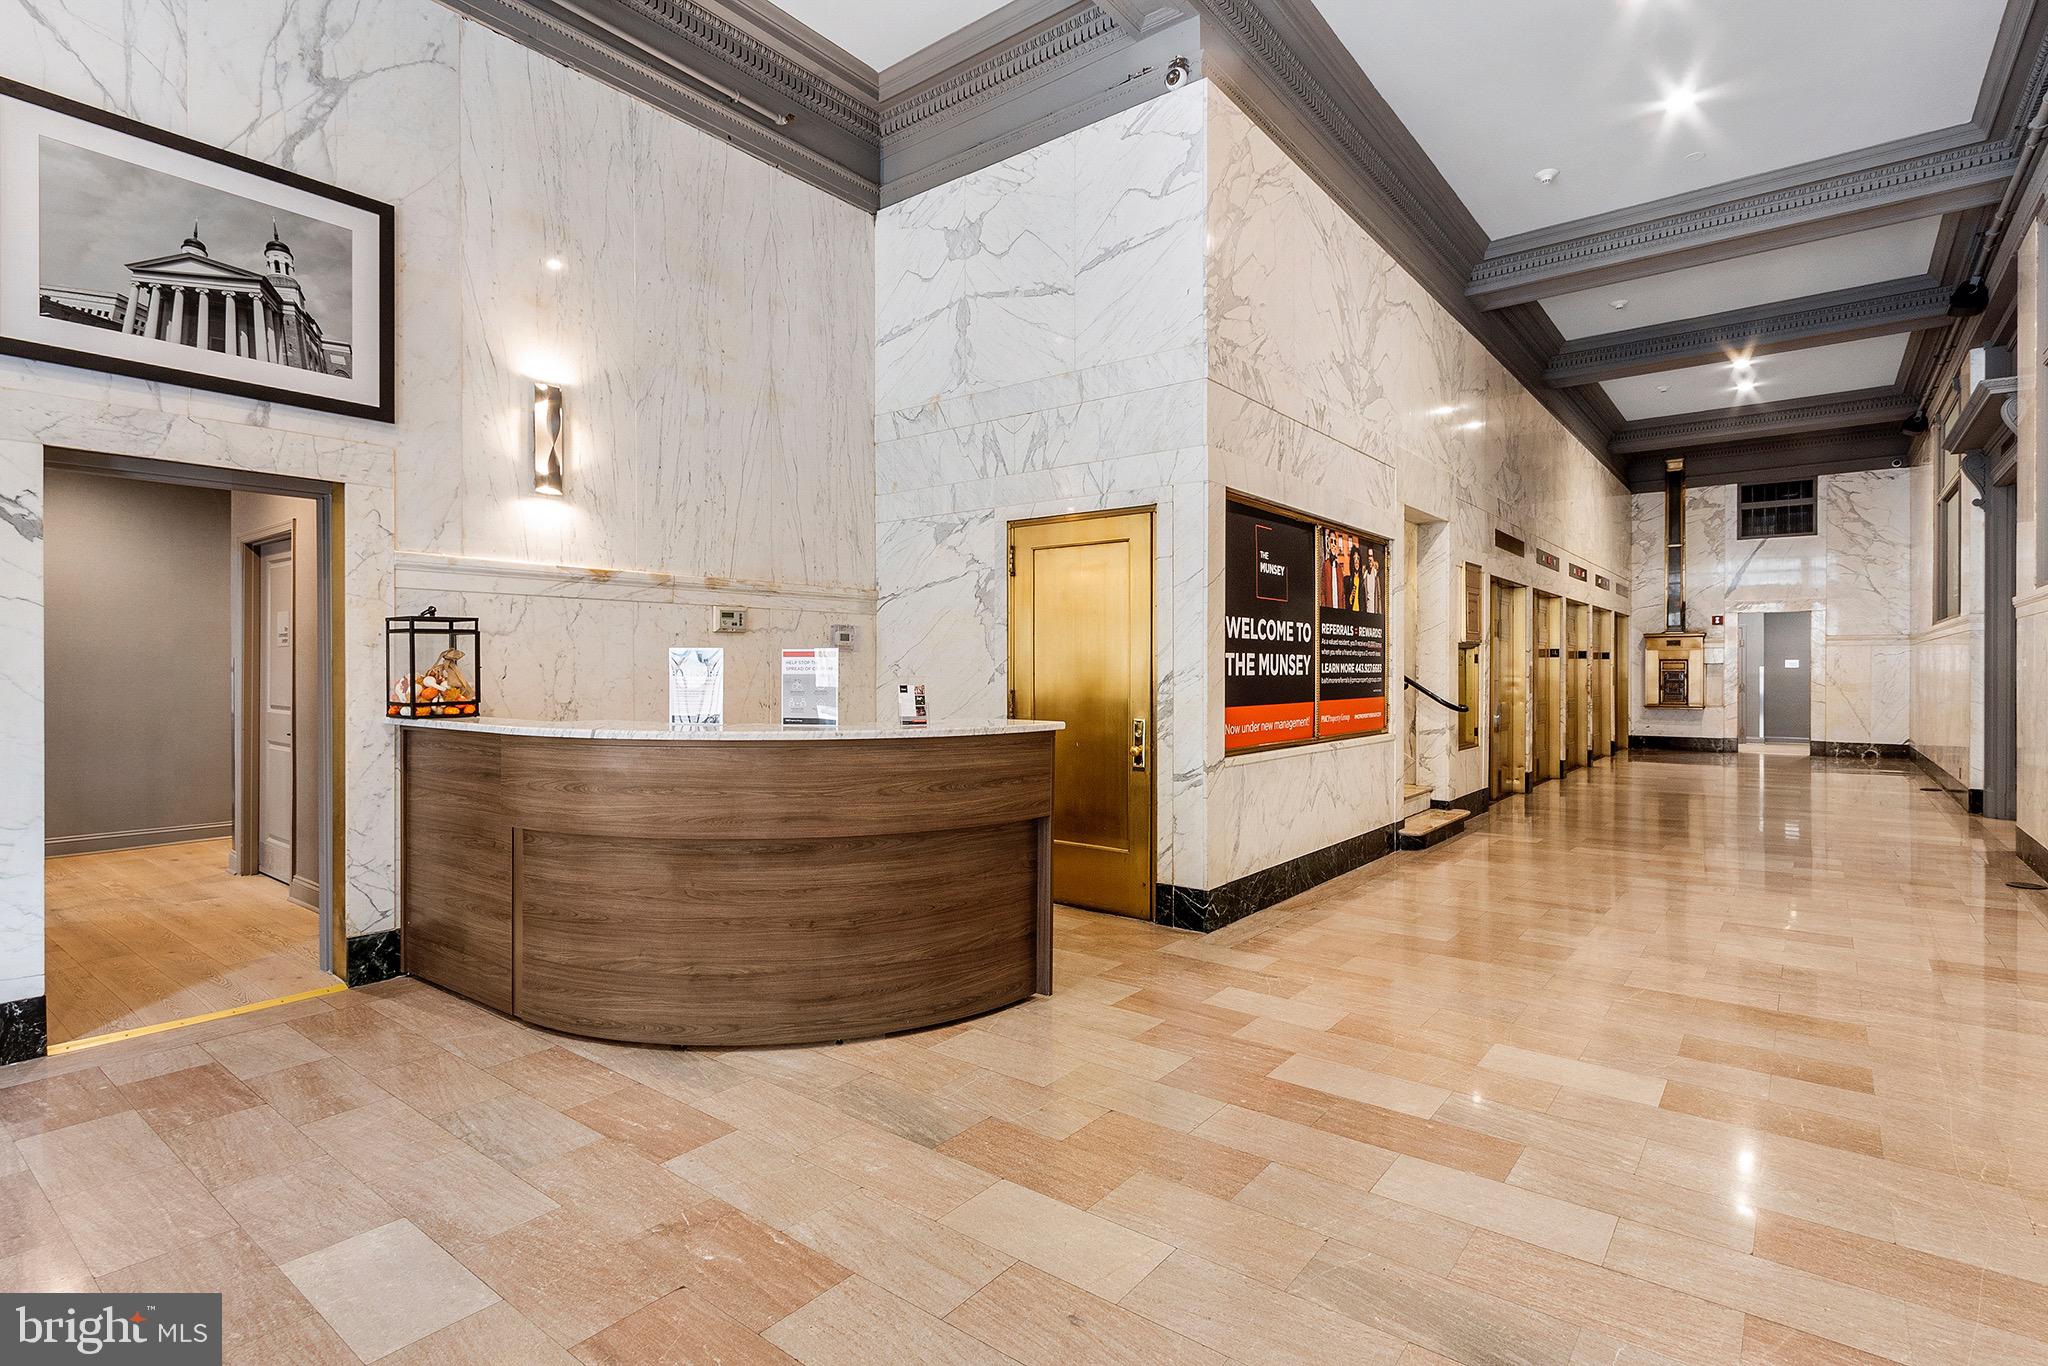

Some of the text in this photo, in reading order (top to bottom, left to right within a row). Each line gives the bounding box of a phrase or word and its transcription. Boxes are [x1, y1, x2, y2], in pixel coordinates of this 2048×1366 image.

[1260, 550, 1269, 560] THE
[1260, 562, 1285, 576] MUNSEY
[1226, 616, 1312, 643] WELCOME TO
[1321, 623, 1354, 636] REFERRALS
[1225, 652, 1312, 676] THE MUNSEY
[1321, 663, 1340, 673] LEARN
[1340, 663, 1355, 673] MORE
[1225, 723, 1240, 735] Now
[1241, 721, 1260, 733] under
[1261, 720, 1273, 731] new
